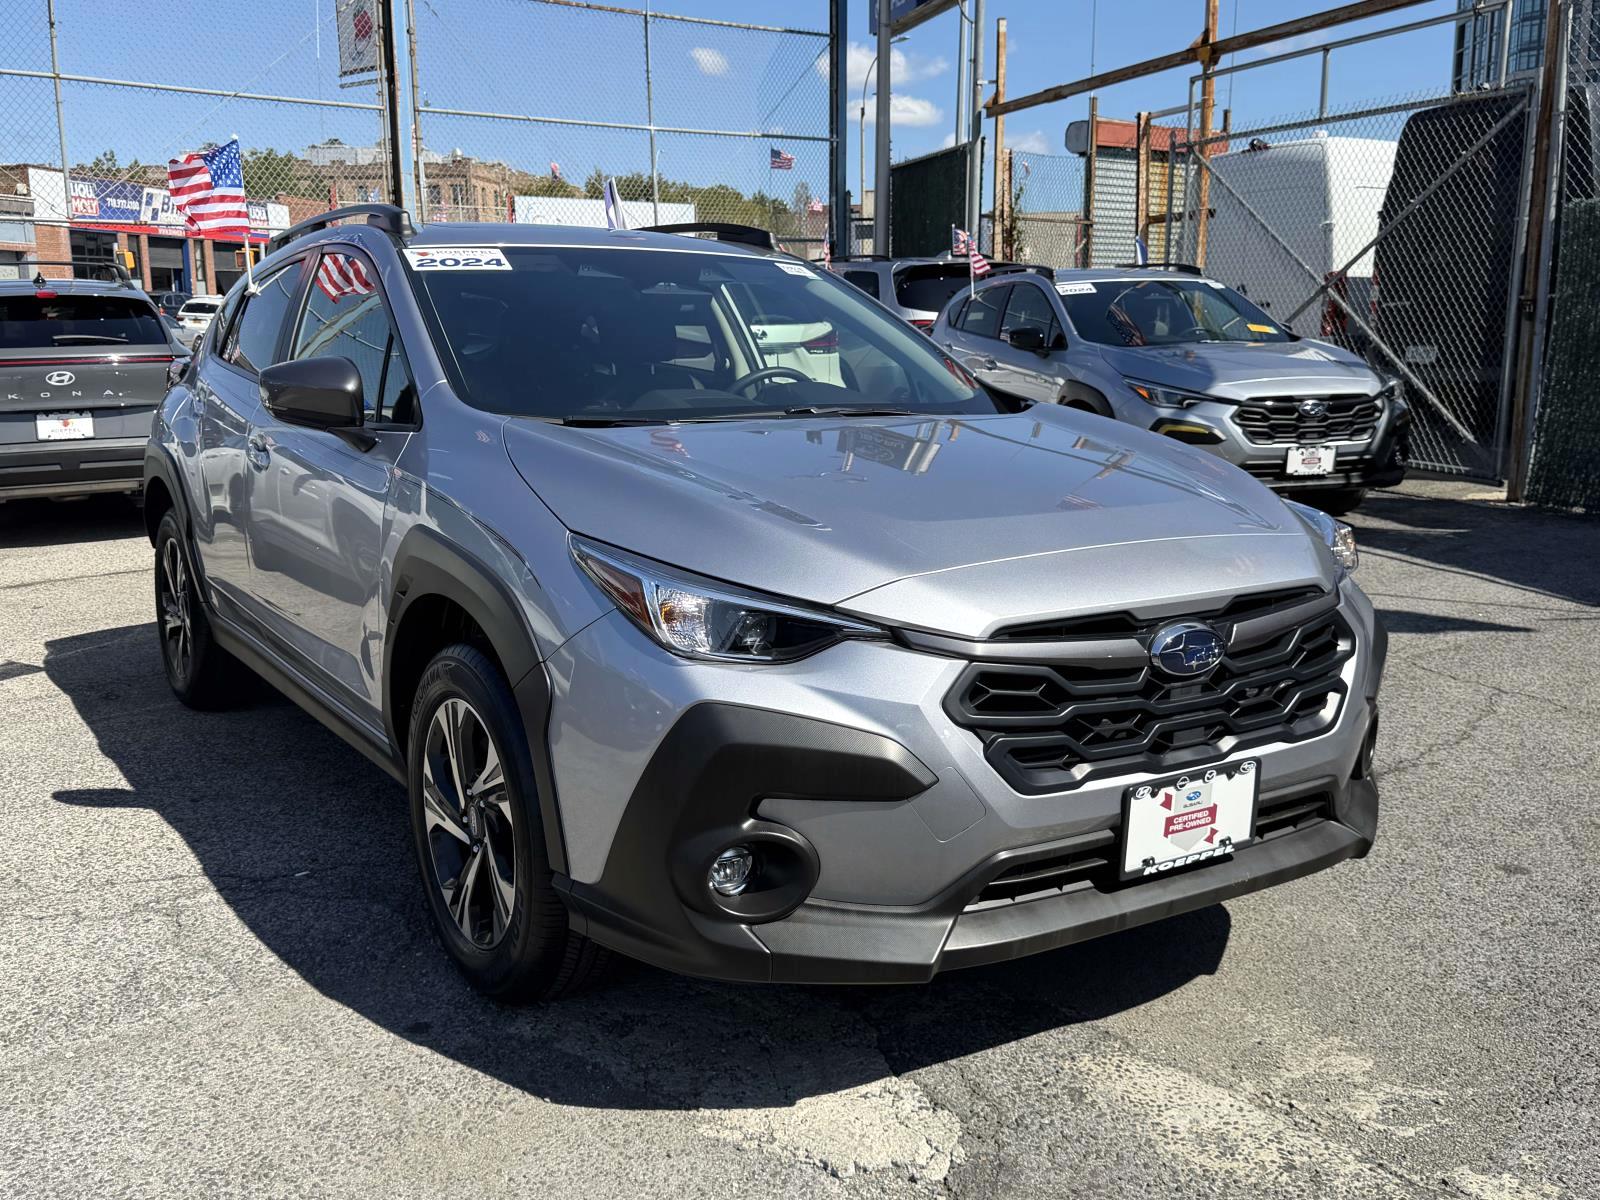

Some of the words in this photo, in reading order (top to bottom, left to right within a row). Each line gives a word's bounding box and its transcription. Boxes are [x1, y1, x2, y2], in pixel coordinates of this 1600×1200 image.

[71, 199, 98, 215] MOLY
[416, 258, 505, 267] 2024
[8, 389, 114, 400] KONA
[1169, 816, 1211, 832] PRE-OWNED
[1173, 810, 1209, 824] CERTIFIED
[1143, 845, 1235, 875] KOEPPEL
